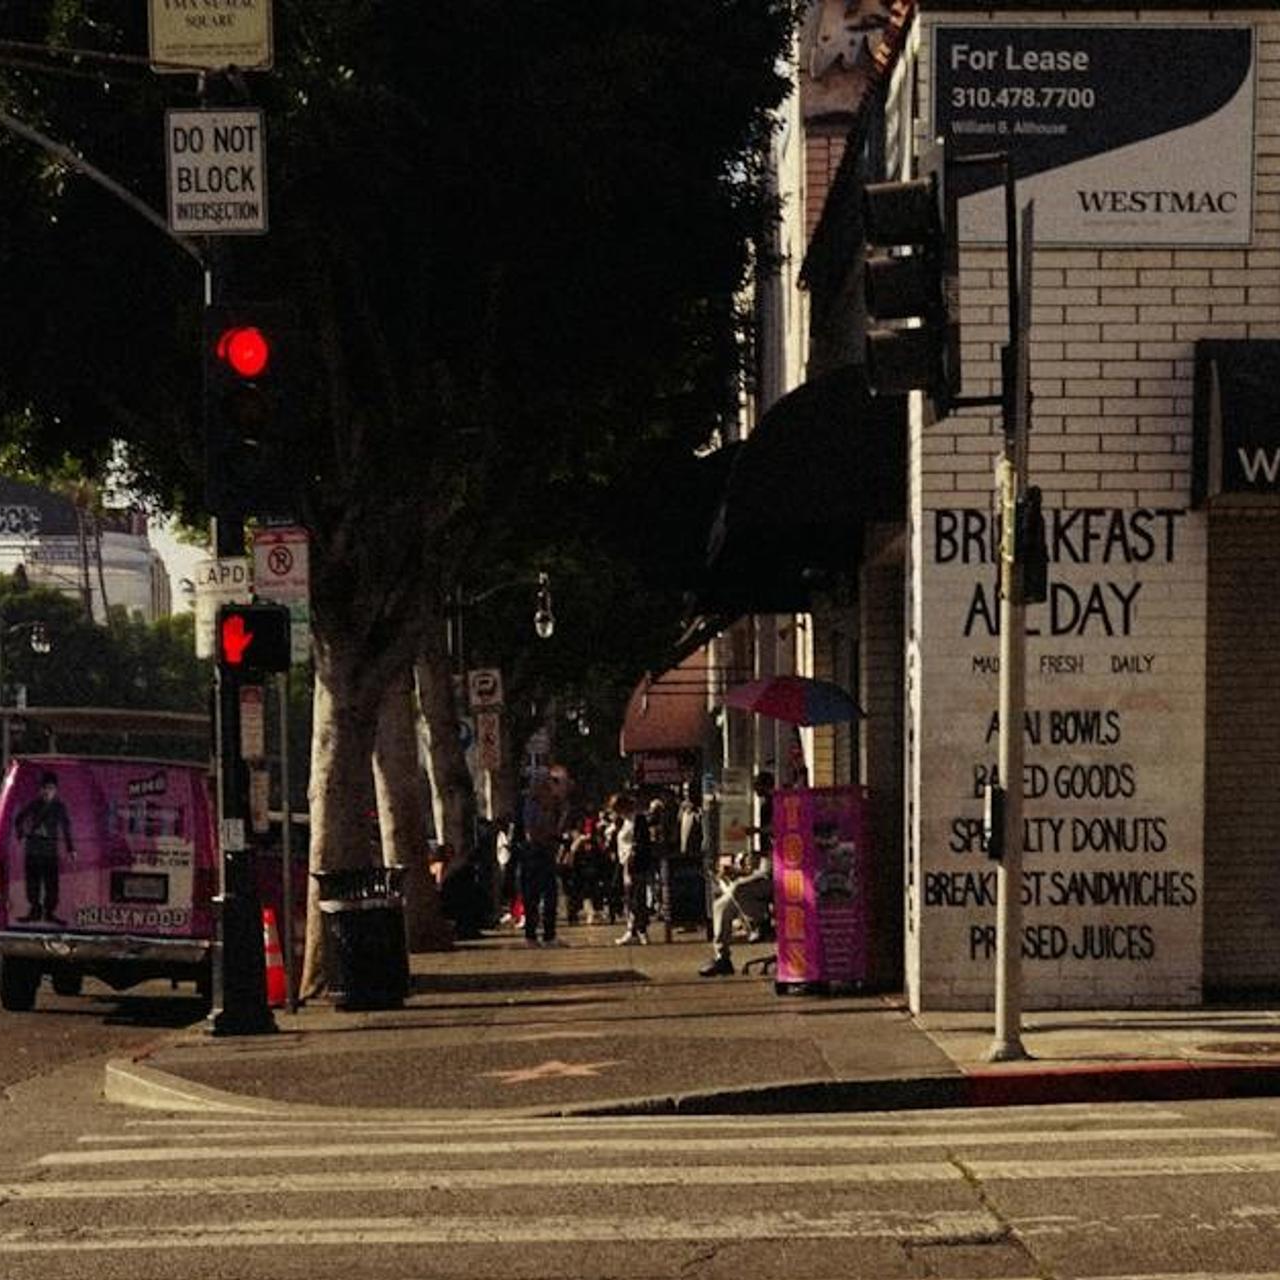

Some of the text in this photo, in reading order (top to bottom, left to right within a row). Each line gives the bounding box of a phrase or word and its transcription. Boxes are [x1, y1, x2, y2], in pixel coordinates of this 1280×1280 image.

[950, 44, 1090, 72] For Lease
[951, 86, 1096, 109] 310.478.7700
[173, 125, 257, 154] DO NOT
[177, 166, 256, 193] BLOCK
[175, 202, 259, 221] INTERSECTION
[1077, 190, 1238, 213] WESTMAC
[935, 508, 1187, 564] BRKFAST
[1051, 582, 1142, 637] DAY
[972, 654, 1156, 674] MAD FRESH DAILY
[985, 710, 1121, 745] AAI BOWLS
[974, 764, 1136, 799] BED GOODS
[1072, 817, 1168, 853] DONUTS
[924, 871, 1198, 907] BREAKST SANDWICHES
[970, 924, 1155, 960] PRSED JUICES
